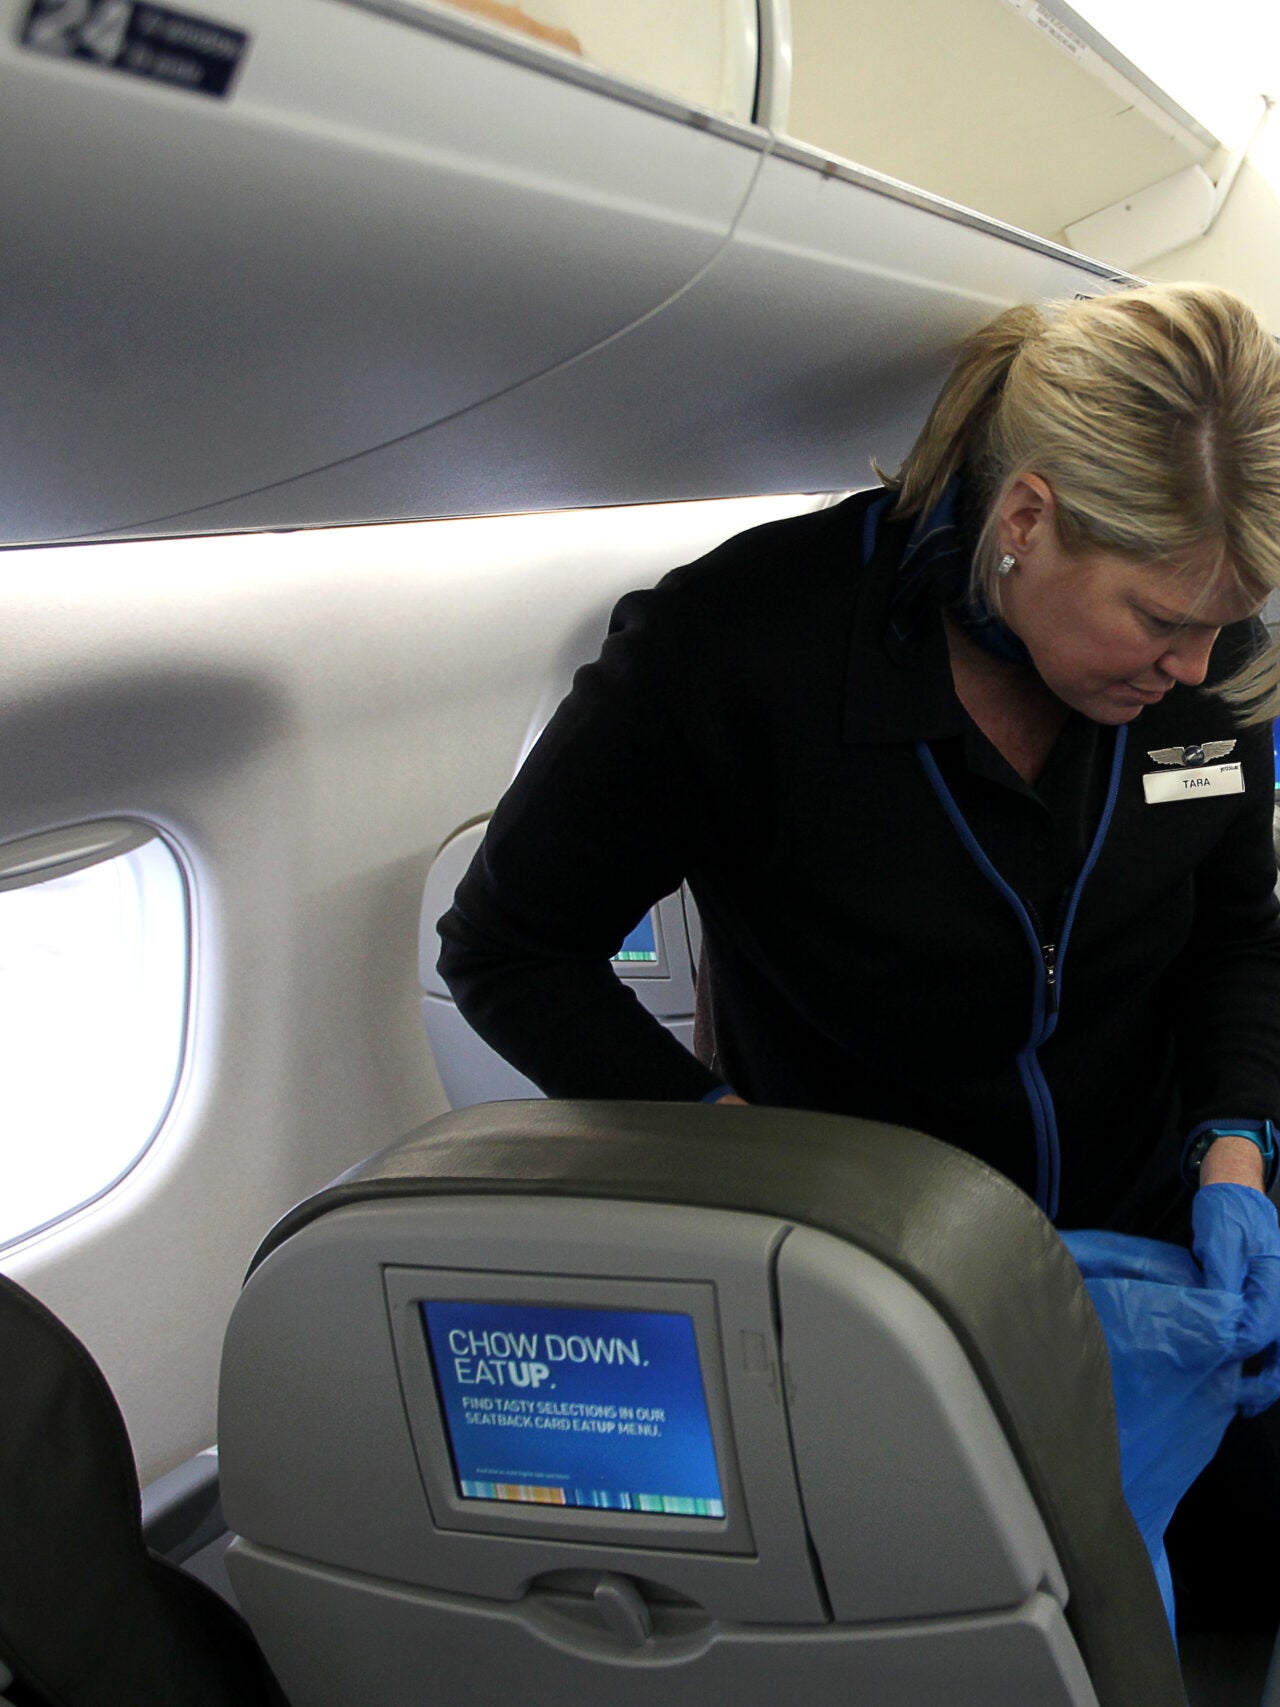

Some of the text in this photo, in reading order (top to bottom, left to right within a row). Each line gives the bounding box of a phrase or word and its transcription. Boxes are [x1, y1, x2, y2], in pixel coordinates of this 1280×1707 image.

[1182, 778, 1211, 788] TARA
[449, 1329, 650, 1367] CHOW DOWN.
[454, 1358, 557, 1389] EATUP.
[462, 1396, 666, 1422] FIND TASTY SELECTIONS IN OUR
[465, 1411, 662, 1437] SEATBACK CARD EATUP MENU.
